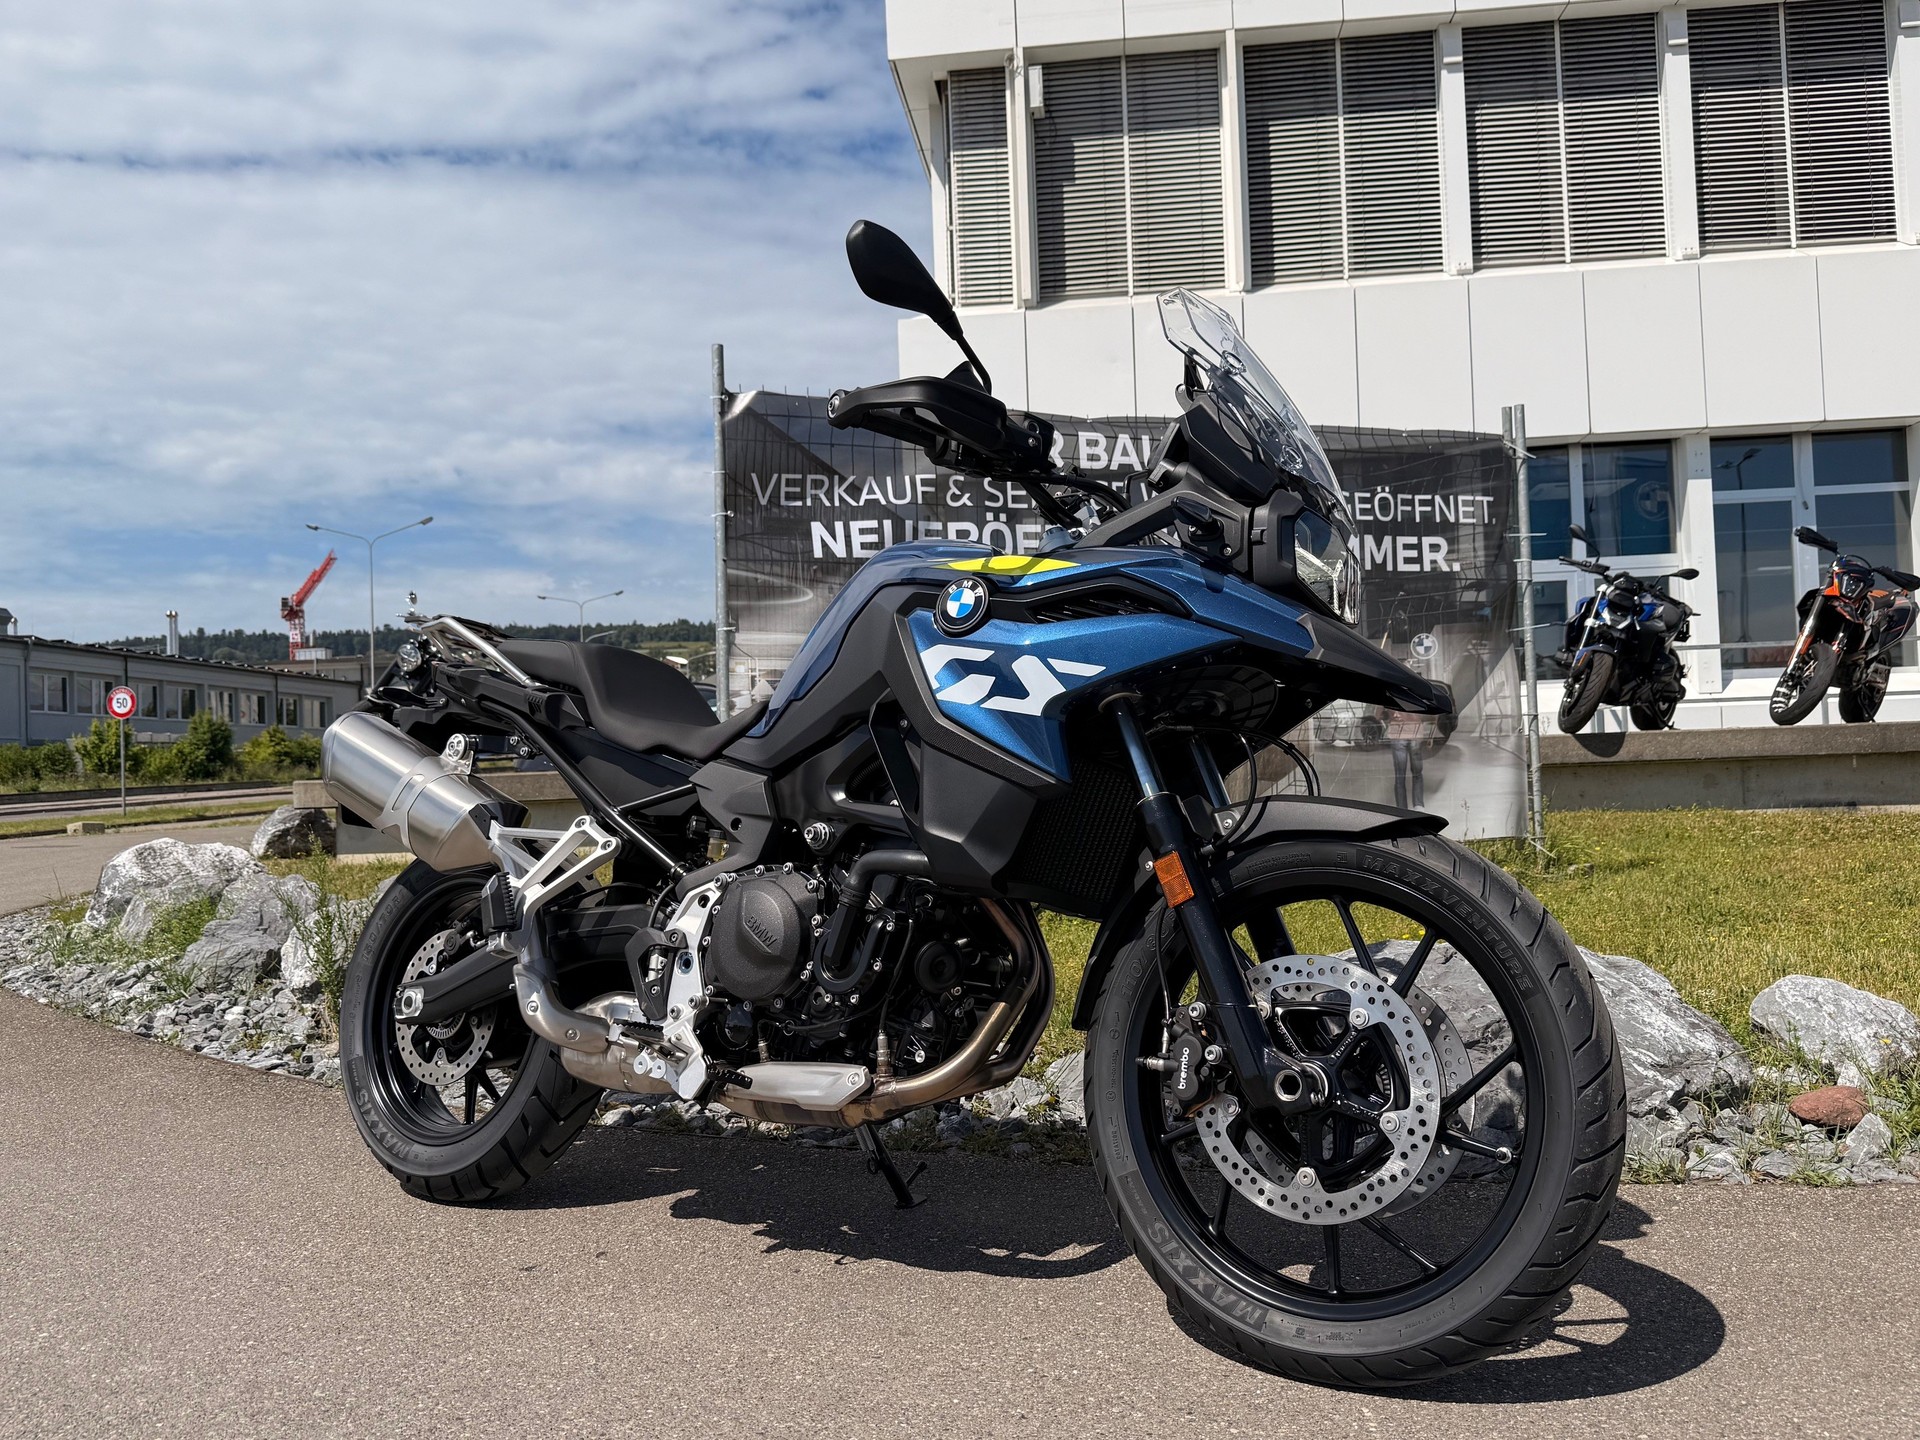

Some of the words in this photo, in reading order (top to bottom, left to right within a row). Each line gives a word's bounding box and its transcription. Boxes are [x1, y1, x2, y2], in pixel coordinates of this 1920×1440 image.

[751, 472, 937, 507] VERKAUF
[946, 475, 974, 508] &
[948, 580, 984, 598] BMW
[116, 697, 128, 709] 50
[745, 915, 778, 948] BMW
[1362, 854, 1533, 991] MAXXVENTURE
[1177, 1047, 1190, 1090] brembo
[355, 1088, 411, 1159] MAXXIS
[1147, 1221, 1263, 1326] MAXXIS
